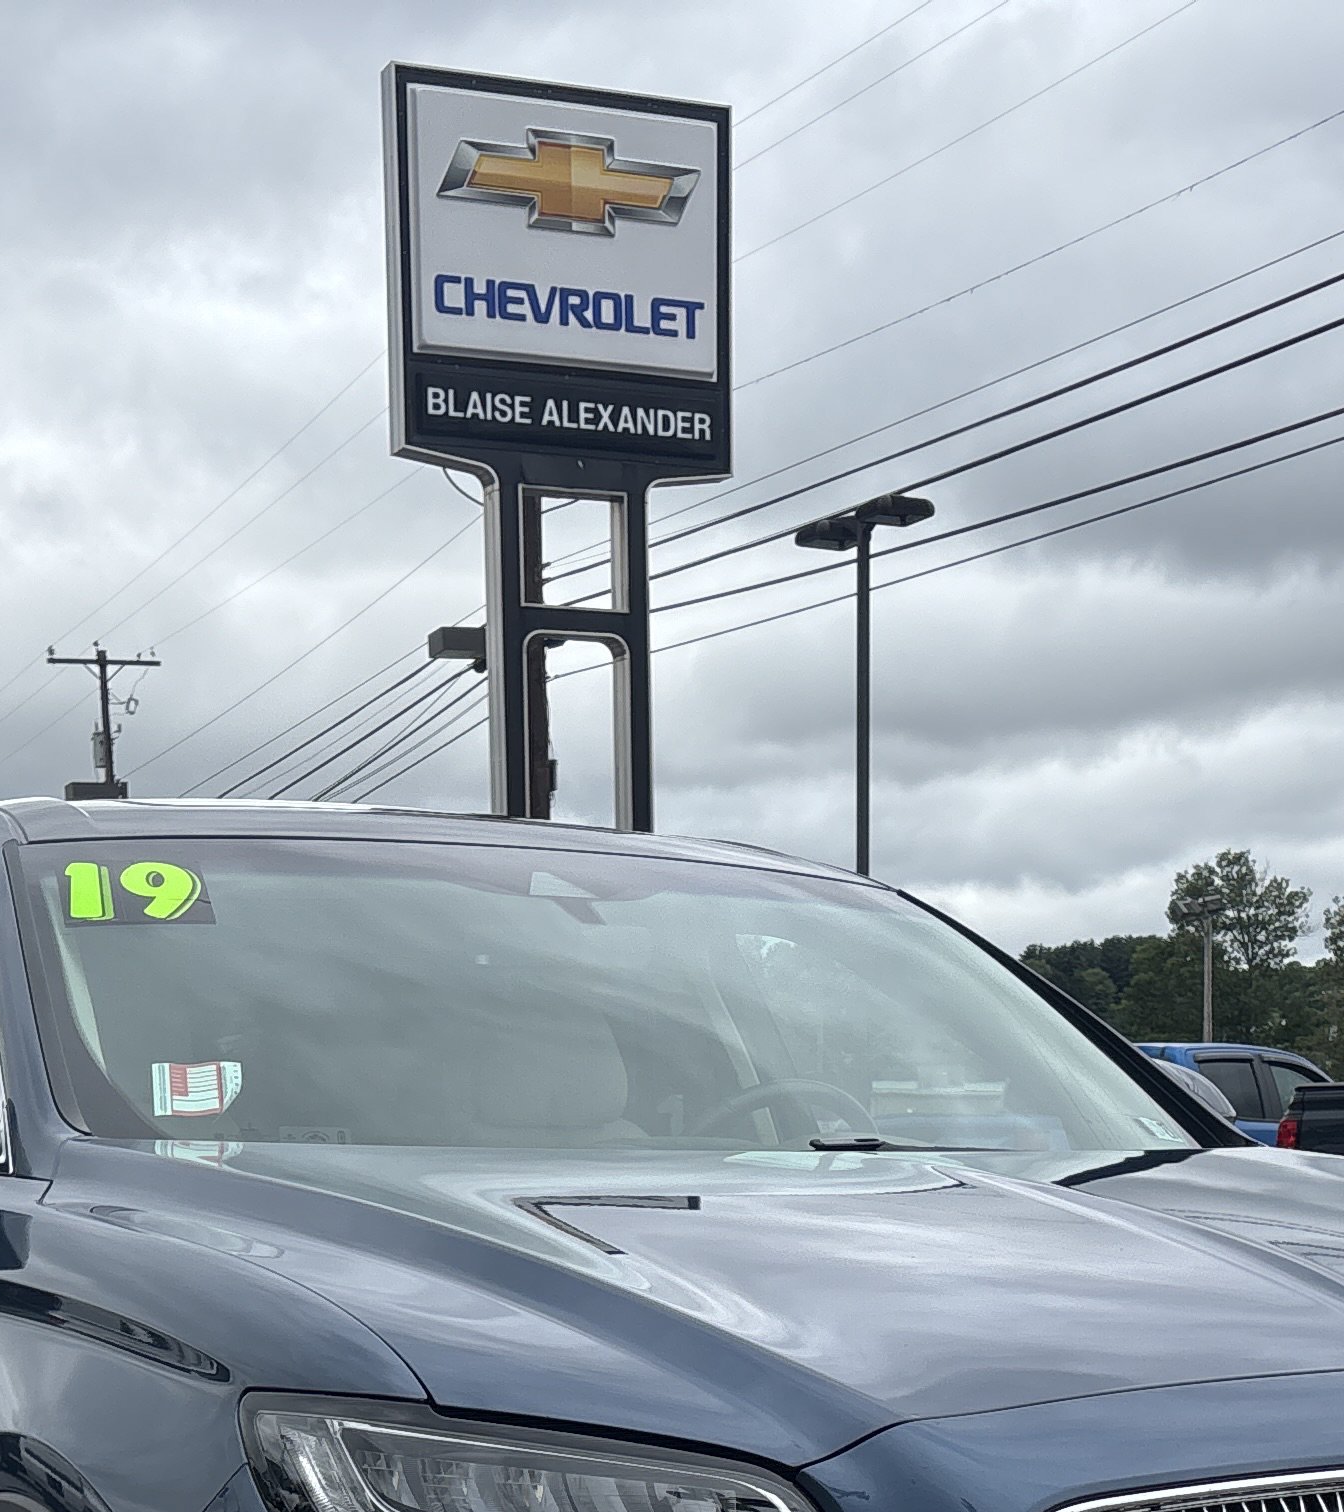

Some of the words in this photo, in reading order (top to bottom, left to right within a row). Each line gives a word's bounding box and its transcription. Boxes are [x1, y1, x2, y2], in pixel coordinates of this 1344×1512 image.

[434, 273, 705, 340] CHEVROLET
[426, 387, 533, 425] BLAISE
[541, 398, 712, 442] ALEXANDER
[64, 861, 202, 921] 19
